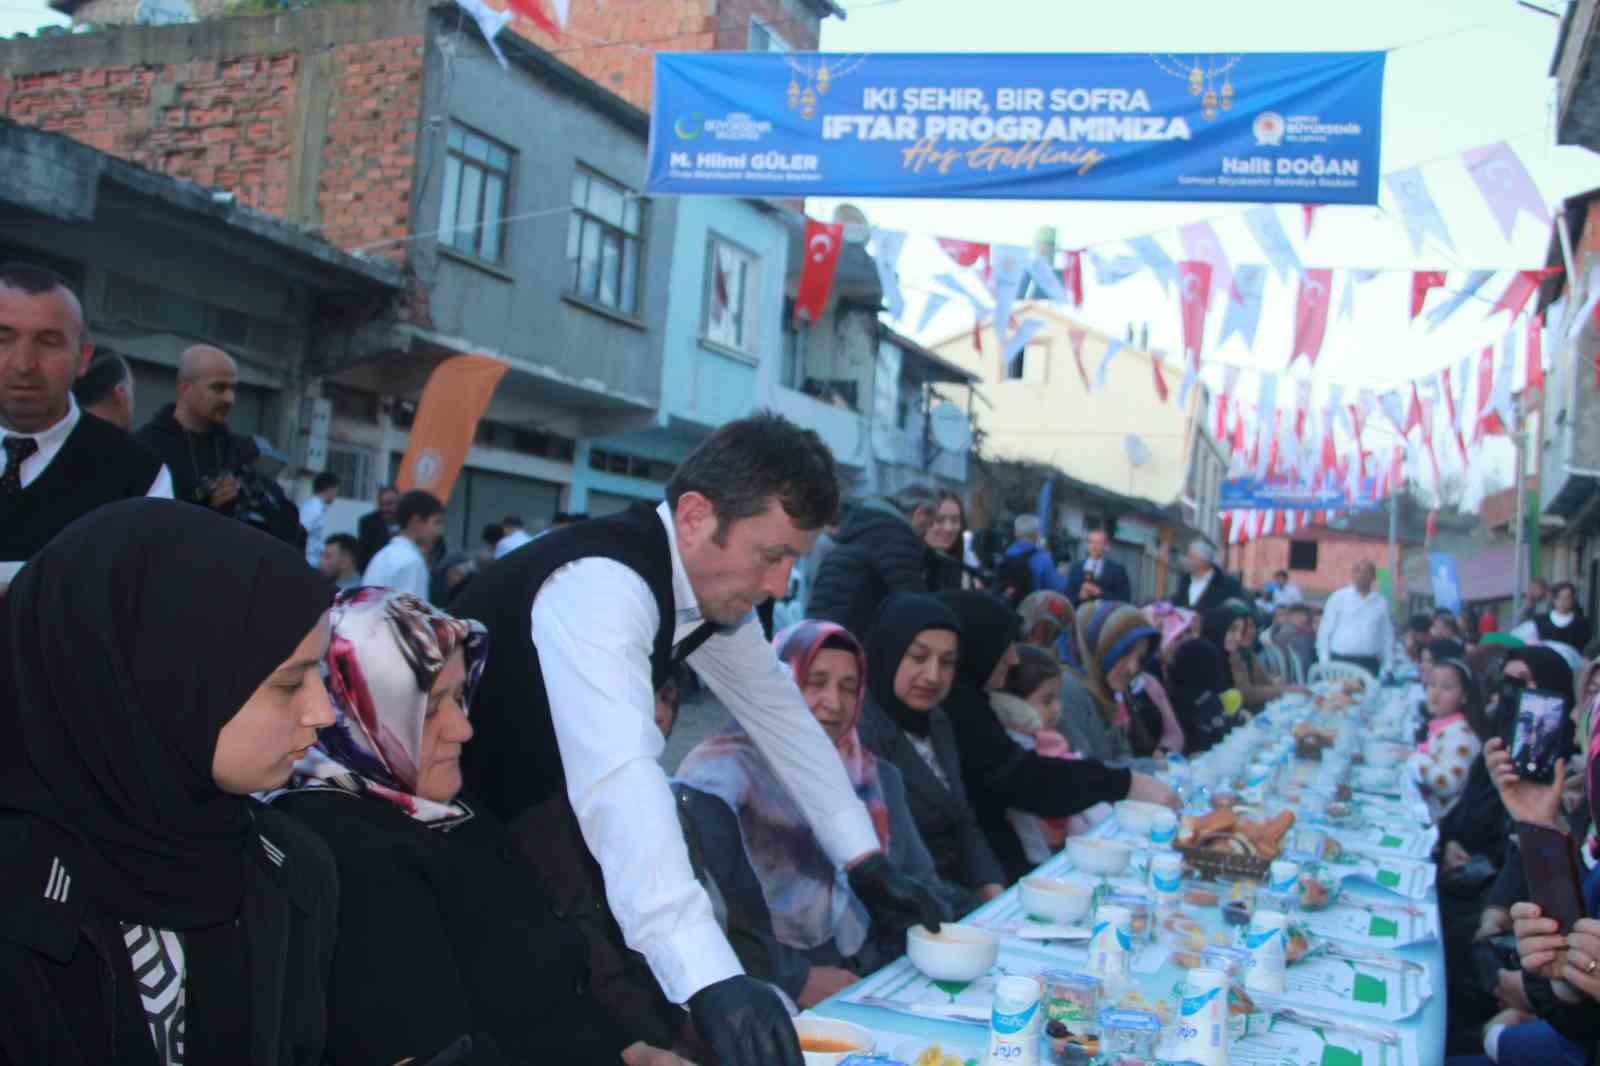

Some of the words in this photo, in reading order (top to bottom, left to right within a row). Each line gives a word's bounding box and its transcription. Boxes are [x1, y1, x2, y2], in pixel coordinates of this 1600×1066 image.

[1050, 87, 1152, 112] SOFRA
[925, 114, 1192, 142] PROGRAMIMIZA
[670, 152, 692, 168] M.
[751, 149, 819, 170] GÜLER
[1222, 156, 1272, 174] Halit
[1276, 153, 1360, 176] DOĞAN
